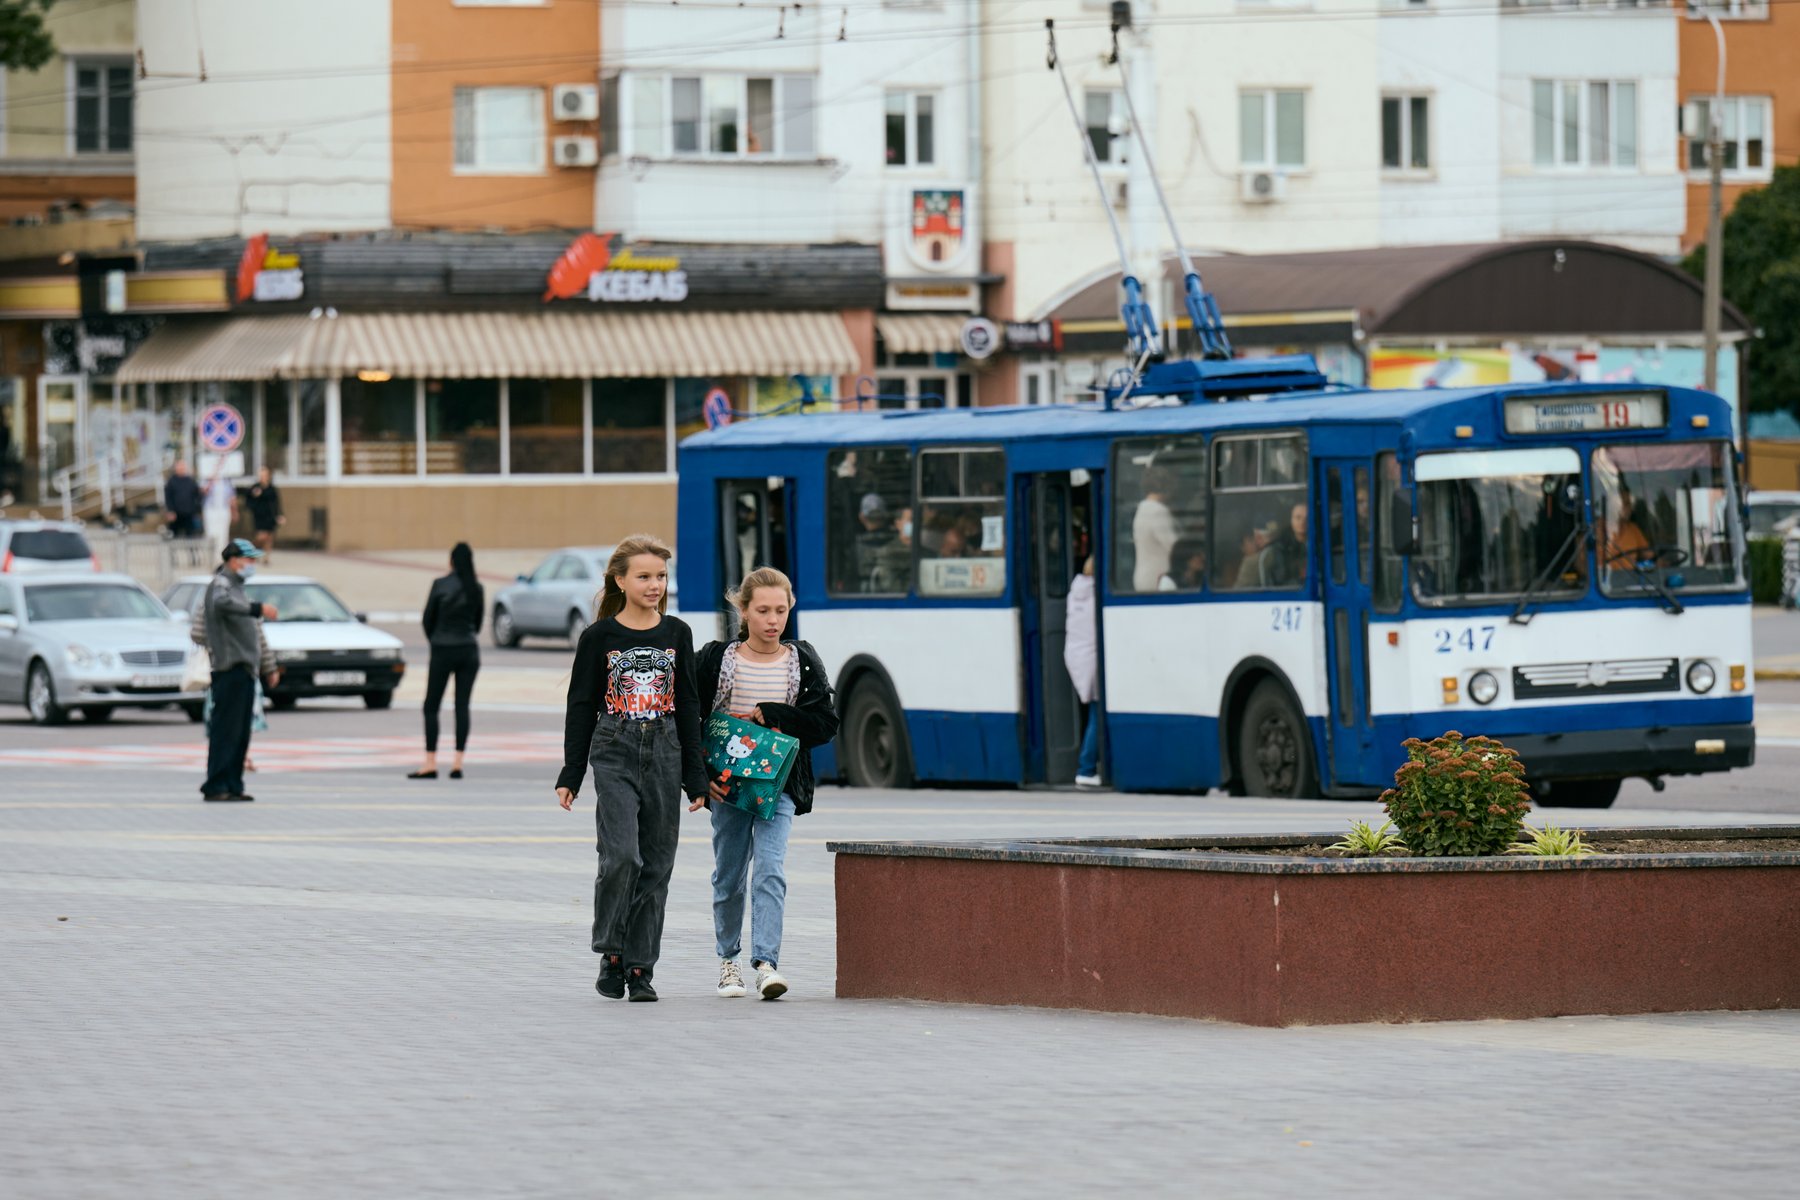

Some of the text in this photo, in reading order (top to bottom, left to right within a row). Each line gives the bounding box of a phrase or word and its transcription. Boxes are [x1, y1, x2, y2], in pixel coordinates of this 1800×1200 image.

[588, 270, 688, 301] КЕБАБ
[1603, 402, 1630, 428] 19
[1271, 607, 1302, 631] 247
[1436, 626, 1496, 653] 247
[613, 693, 671, 713] KENZO
[709, 719, 729, 728] Hello
[709, 727, 730, 739] Kitty
